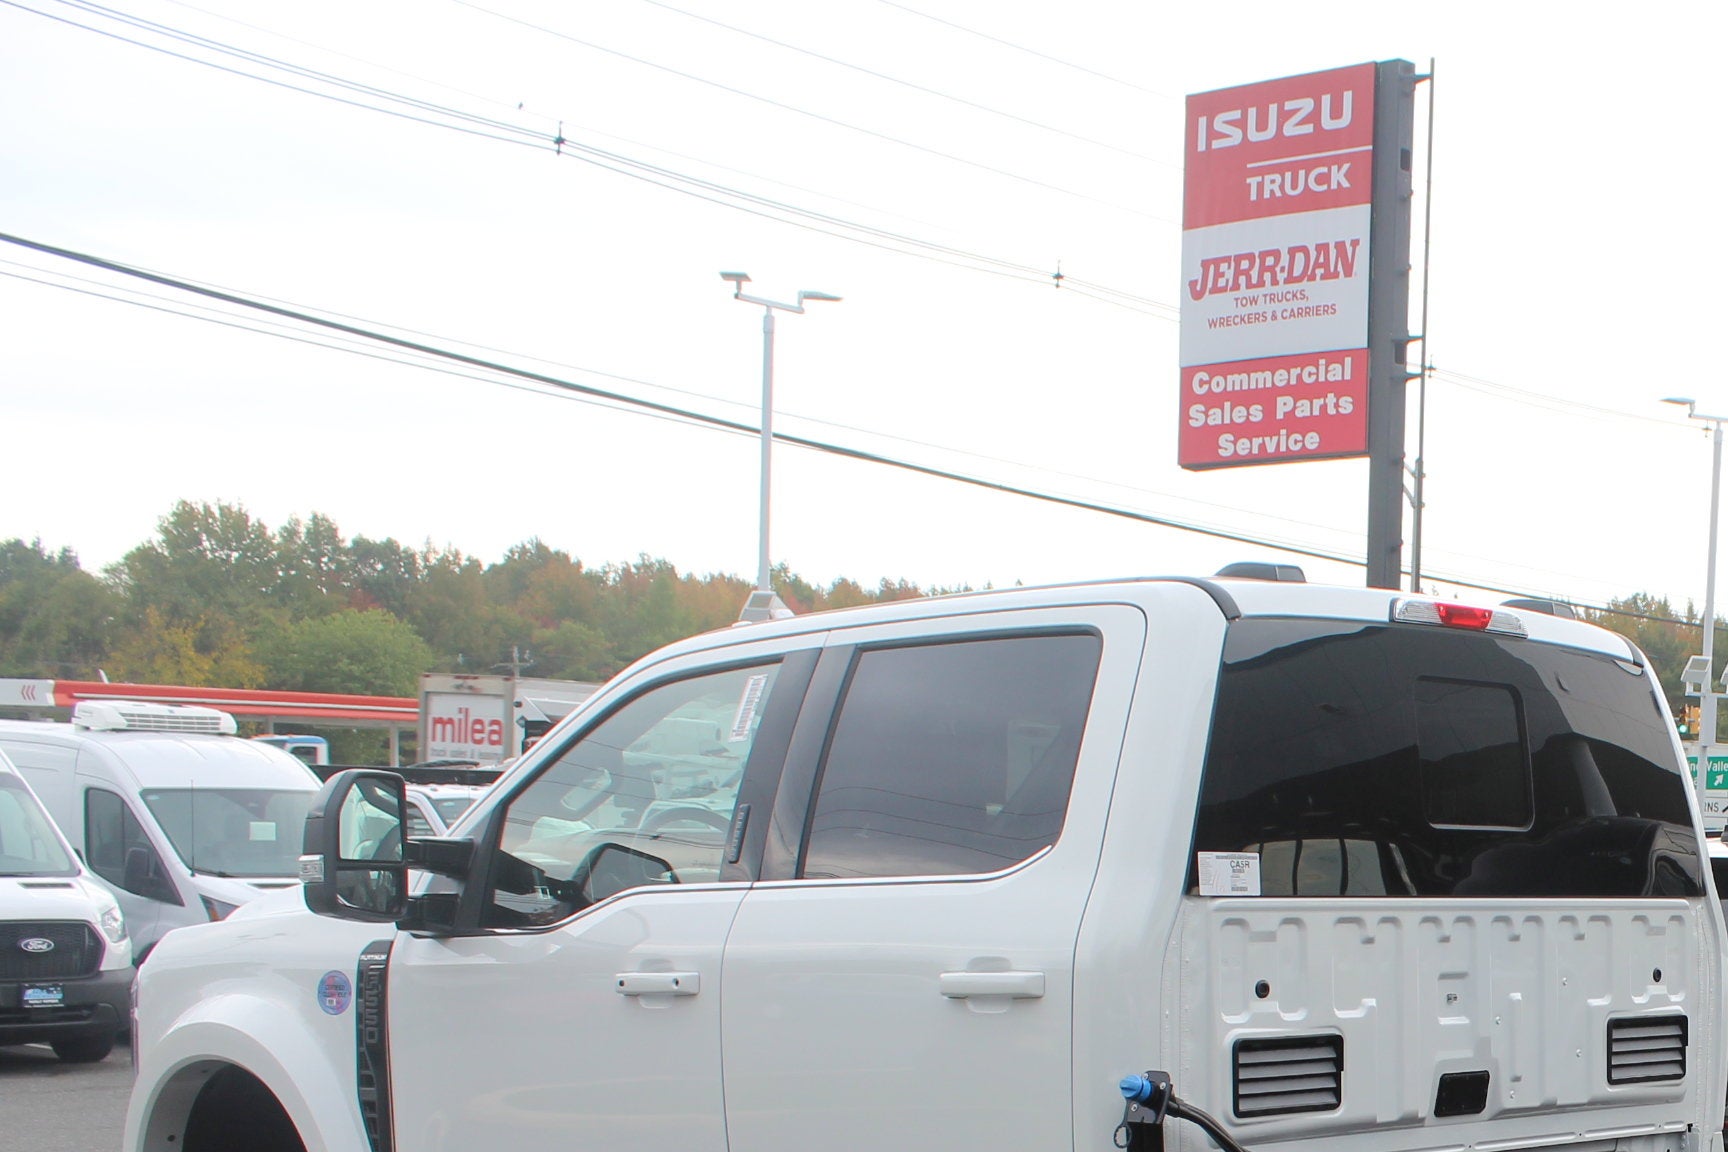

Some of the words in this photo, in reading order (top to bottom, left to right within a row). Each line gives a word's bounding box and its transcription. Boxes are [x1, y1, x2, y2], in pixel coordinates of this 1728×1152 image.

[1197, 90, 1352, 152] ISUZU
[1246, 162, 1351, 201] TRUCK
[1208, 311, 1268, 330] WRECKERS
[1271, 310, 1279, 321] &
[1281, 303, 1337, 321] CARRIERS
[1234, 295, 1260, 309] TOW
[1263, 289, 1309, 304] TRUCKS,
[1192, 356, 1352, 395] Commercial
[1188, 401, 1264, 428] Sales
[1276, 393, 1354, 420] Parts
[1218, 429, 1320, 457] Service
[431, 707, 503, 746] milea
